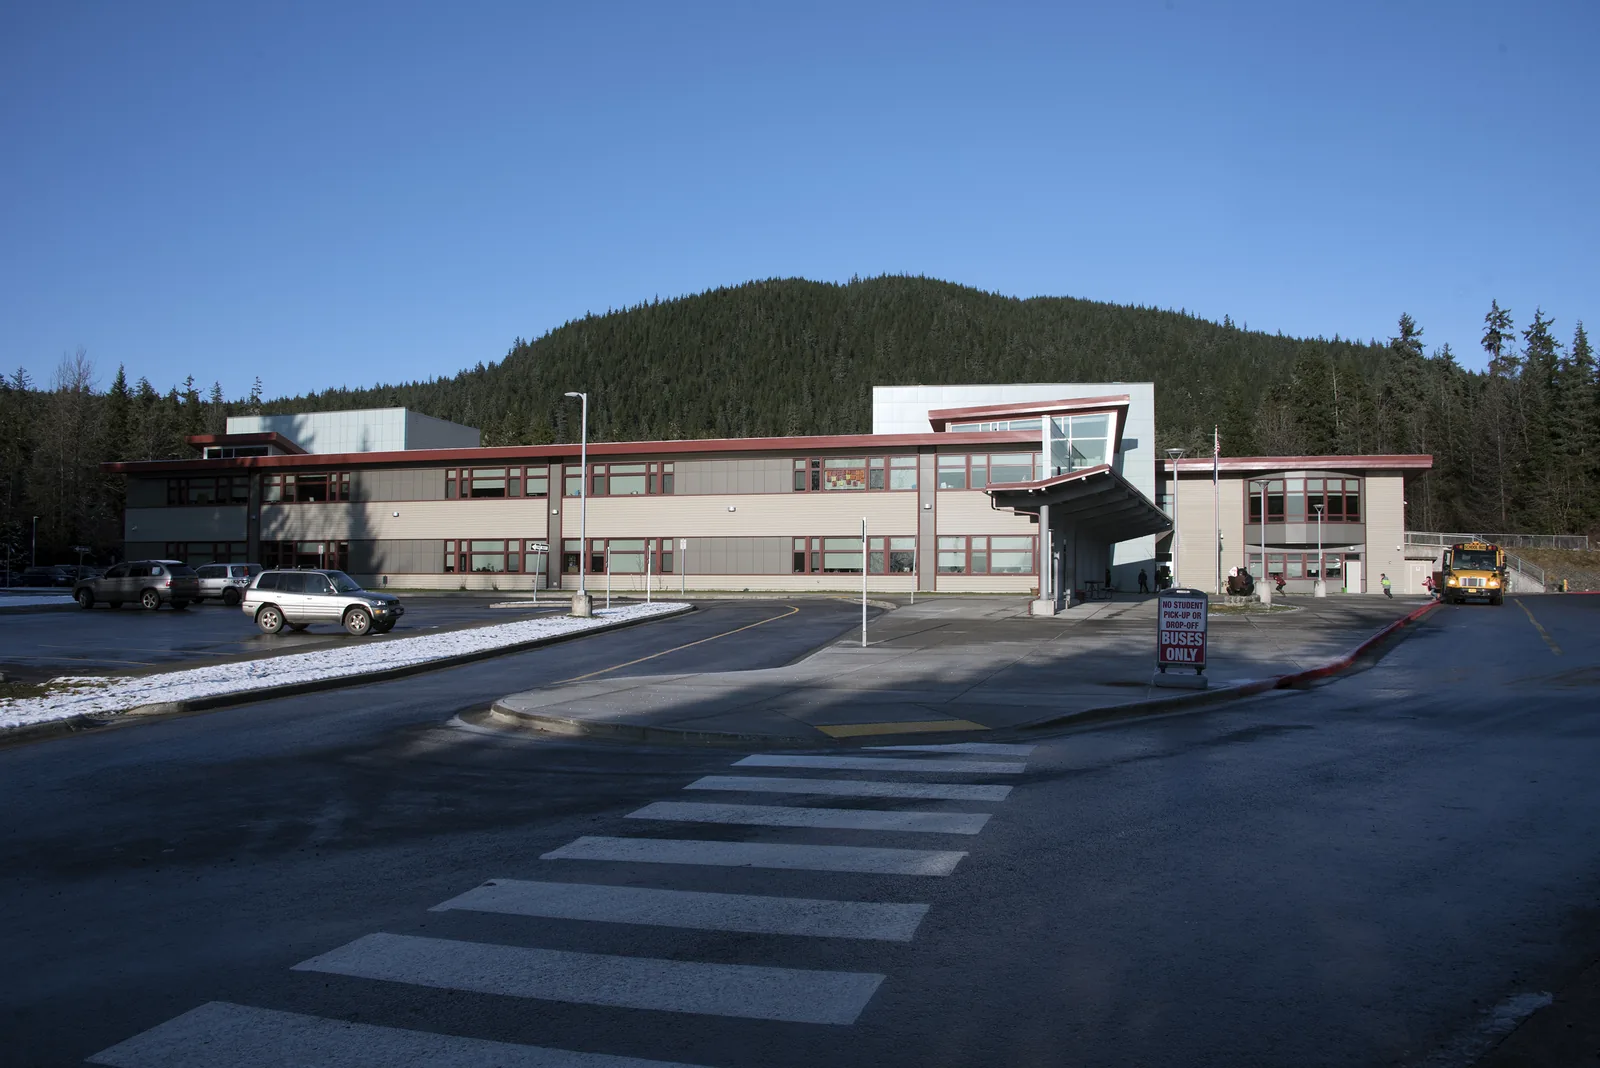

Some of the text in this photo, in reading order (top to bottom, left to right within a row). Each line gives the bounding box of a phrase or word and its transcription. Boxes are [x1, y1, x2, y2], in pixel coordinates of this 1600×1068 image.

[1162, 601, 1203, 610] NO STUDENT
[1163, 611, 1202, 620] PICK-UP OR
[1165, 621, 1199, 629] DROP-OFF
[1161, 631, 1203, 646] BUSES
[1166, 647, 1198, 661] ONLY
